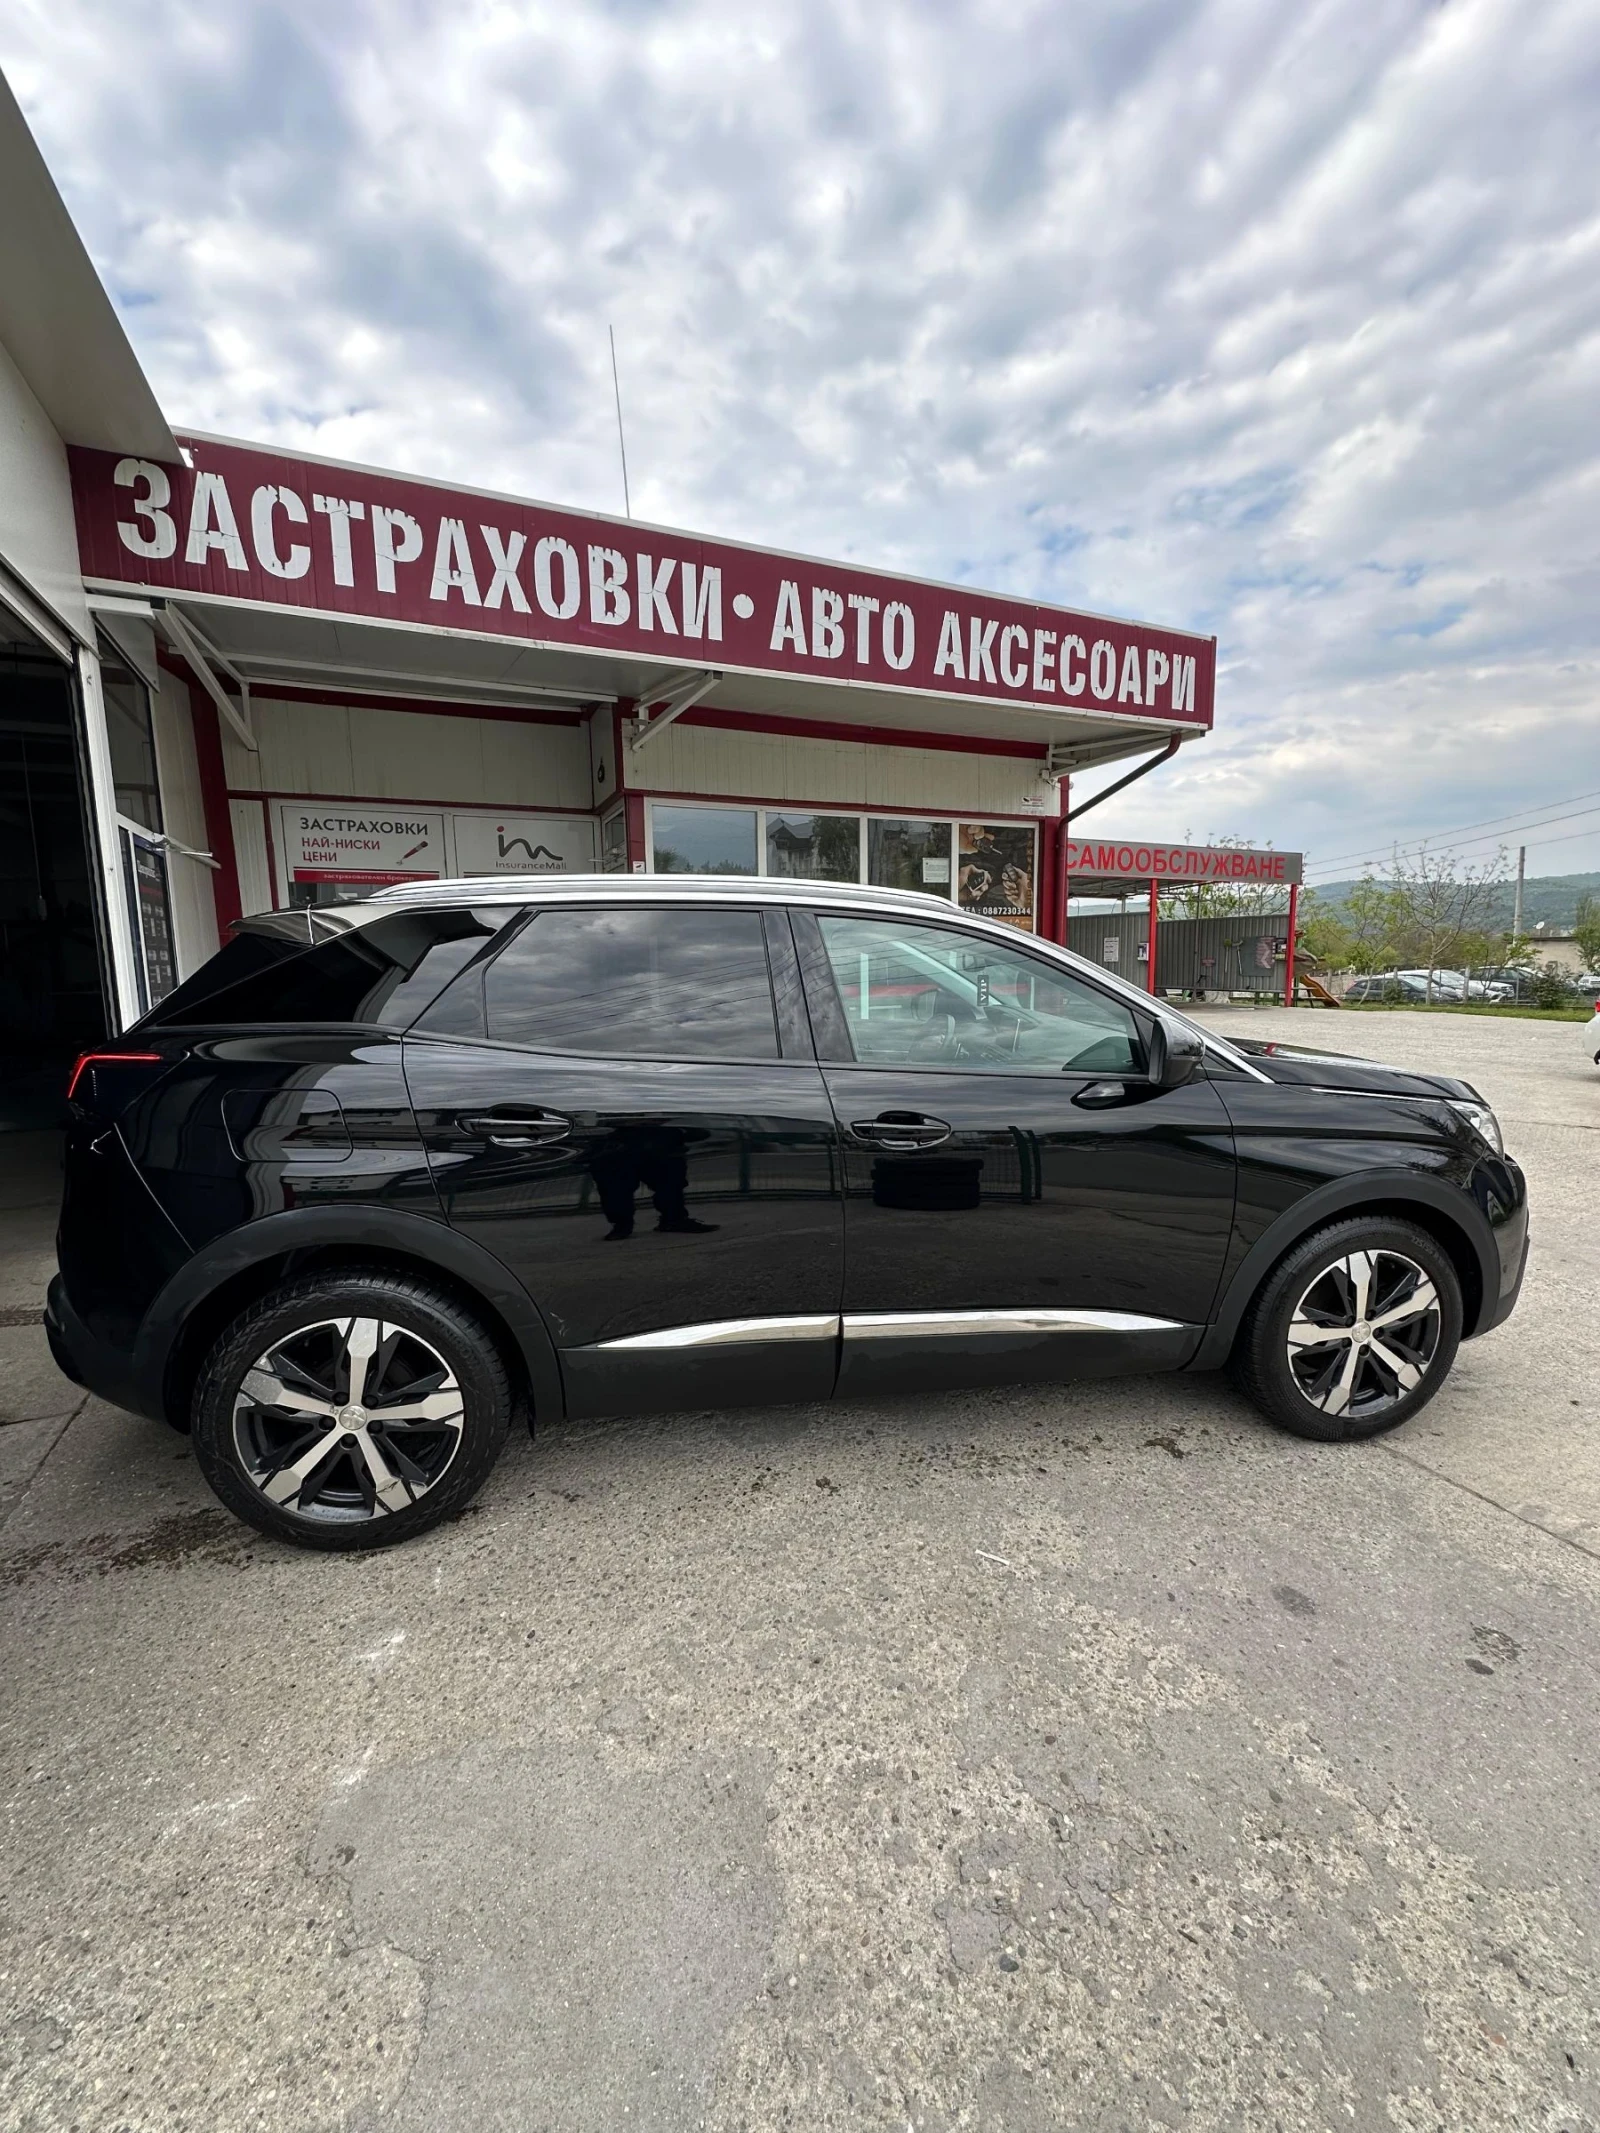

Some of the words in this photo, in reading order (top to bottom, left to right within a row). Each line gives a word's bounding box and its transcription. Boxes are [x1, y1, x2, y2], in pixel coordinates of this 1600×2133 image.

[113, 458, 723, 642] ЗАСТРАХОВКИ
[770, 579, 915, 670] АВТО
[933, 610, 1196, 712] АКСЕСОАРИ
[300, 817, 429, 835] ЗАСТРАХОВКИ
[301, 837, 380, 850] НАЙ-НИСКИ
[302, 851, 337, 863] ЦЕНИ
[1066, 843, 1286, 879] САМООБСЛУЖВАНЕ
[495, 860, 567, 870] InsuranceMall
